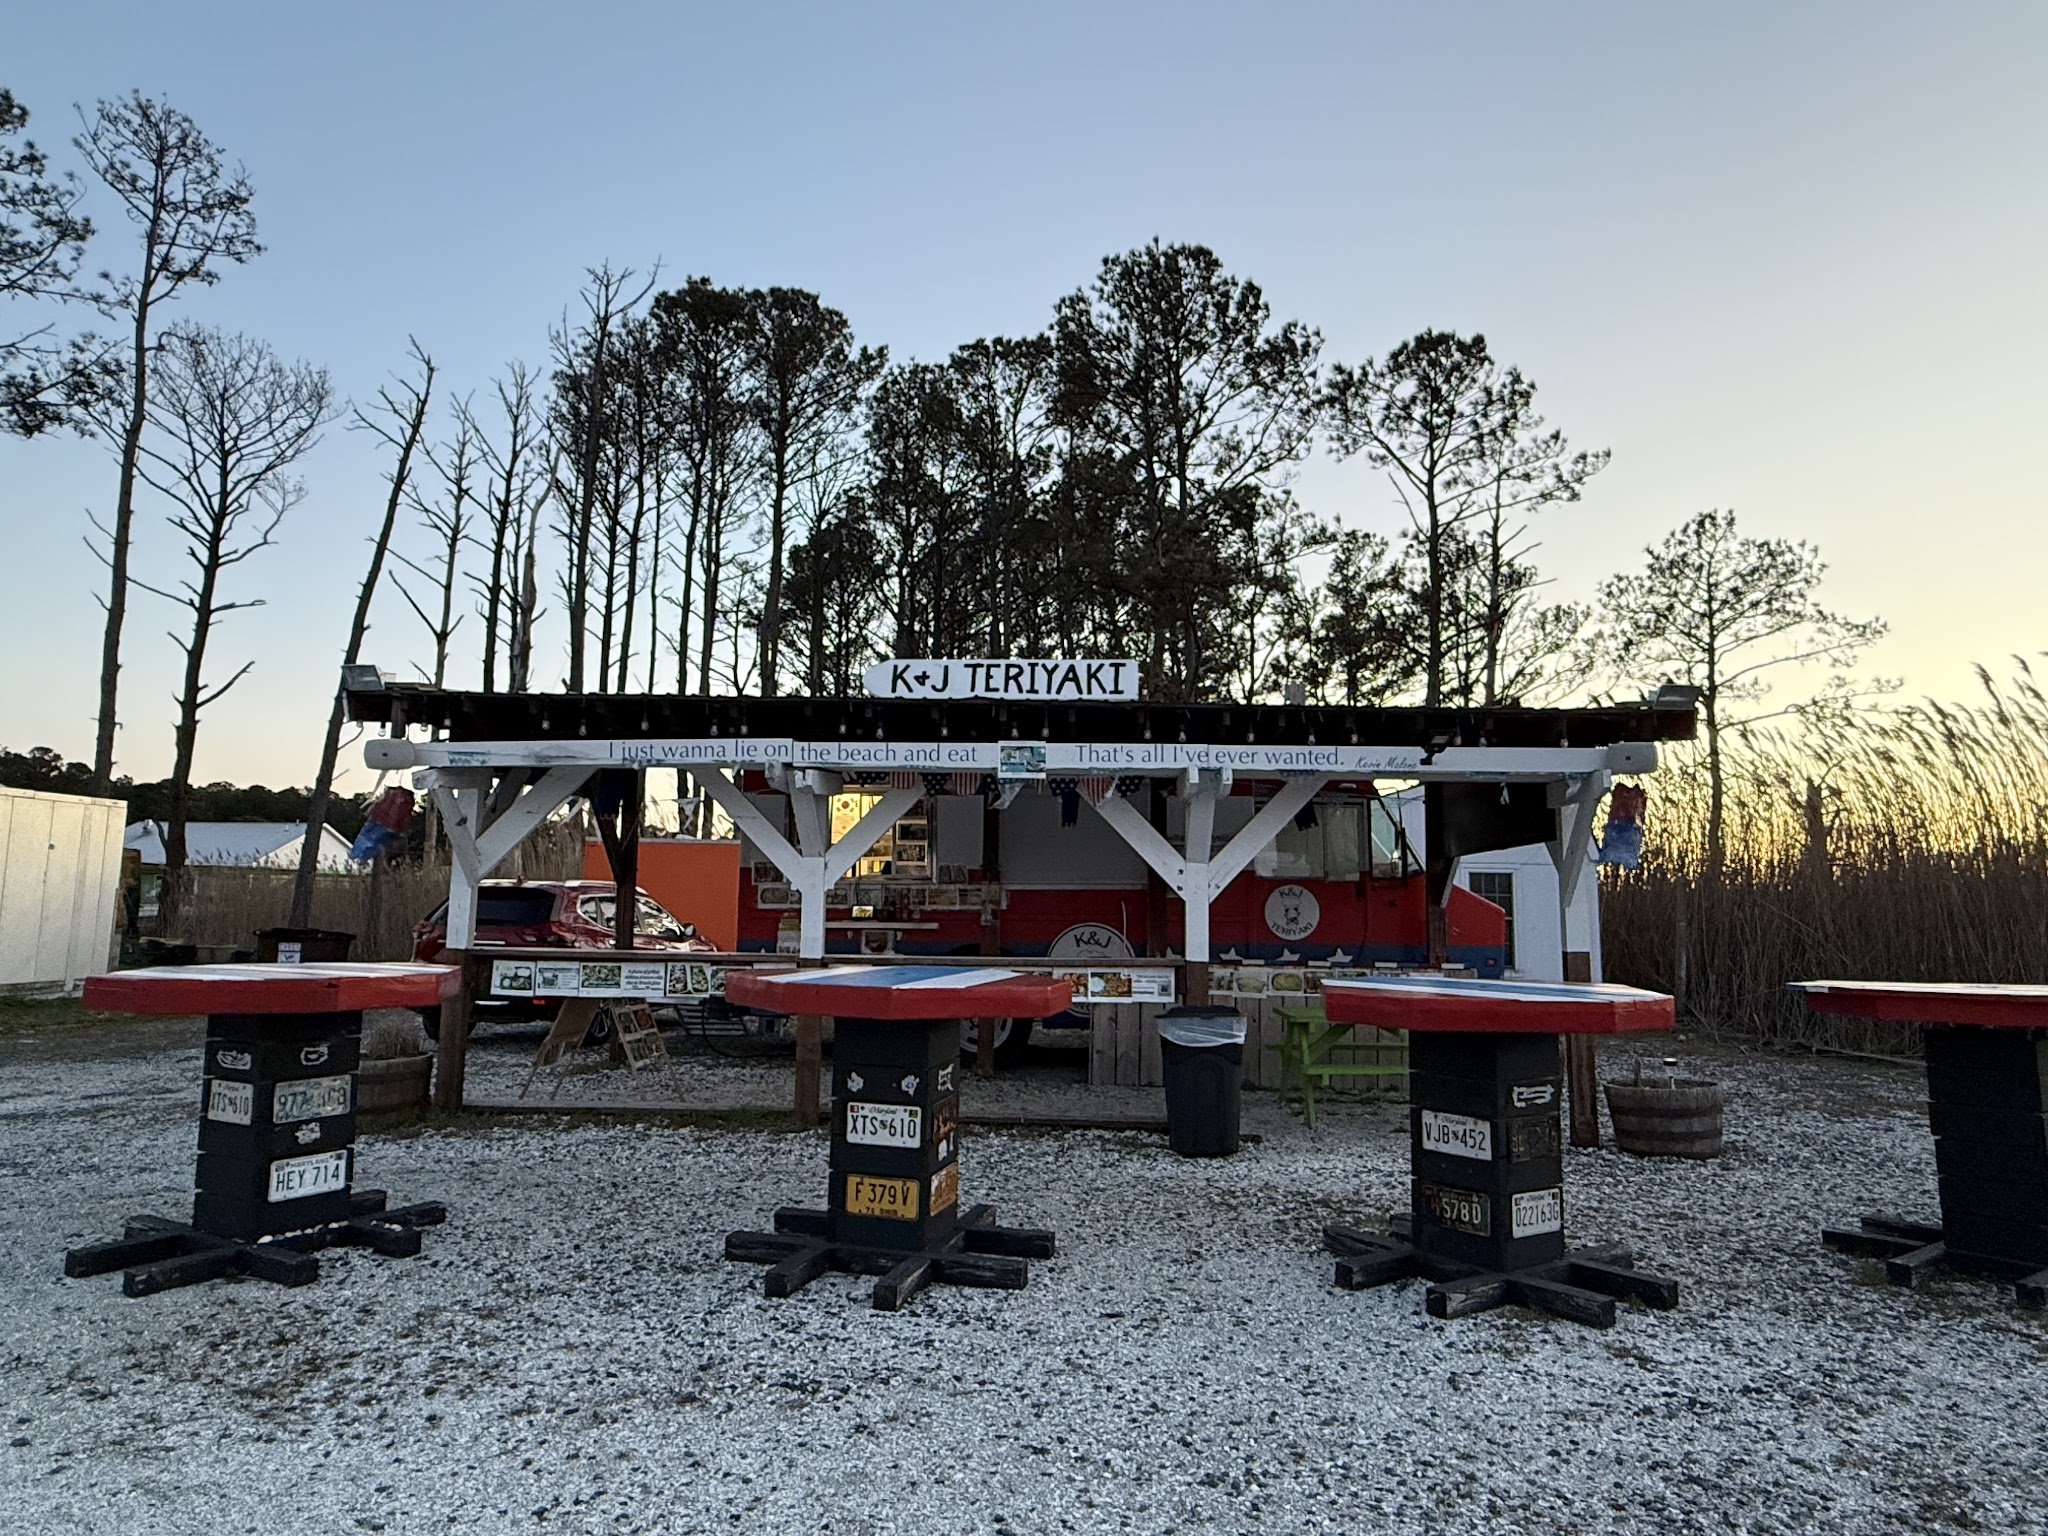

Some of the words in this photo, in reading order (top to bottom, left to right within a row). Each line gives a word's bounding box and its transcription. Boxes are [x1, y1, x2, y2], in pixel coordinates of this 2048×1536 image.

[963, 662, 1127, 695] TERIYAKI
[609, 741, 613, 759] I
[620, 741, 656, 764] just
[661, 744, 727, 759] wanna
[734, 739, 758, 758] lie
[764, 744, 789, 758] on
[800, 743, 831, 762] the
[837, 743, 897, 762] beach
[903, 744, 940, 763] and
[947, 746, 977, 763] eat
[1074, 744, 1135, 763] That's
[1139, 744, 1165, 764] all
[1173, 745, 1209, 764] I've
[1214, 750, 1258, 765] ever
[1264, 746, 1345, 766] wanted.
[1278, 886, 1304, 899] K&J
[1073, 930, 1112, 948] K&J
[850, 1115, 878, 1136] XTS
[888, 1117, 917, 1139] 610
[1424, 1121, 1450, 1145] VJB
[1460, 1128, 1486, 1151] 452
[275, 1168, 305, 1193] HEY
[312, 1162, 340, 1186] 714
